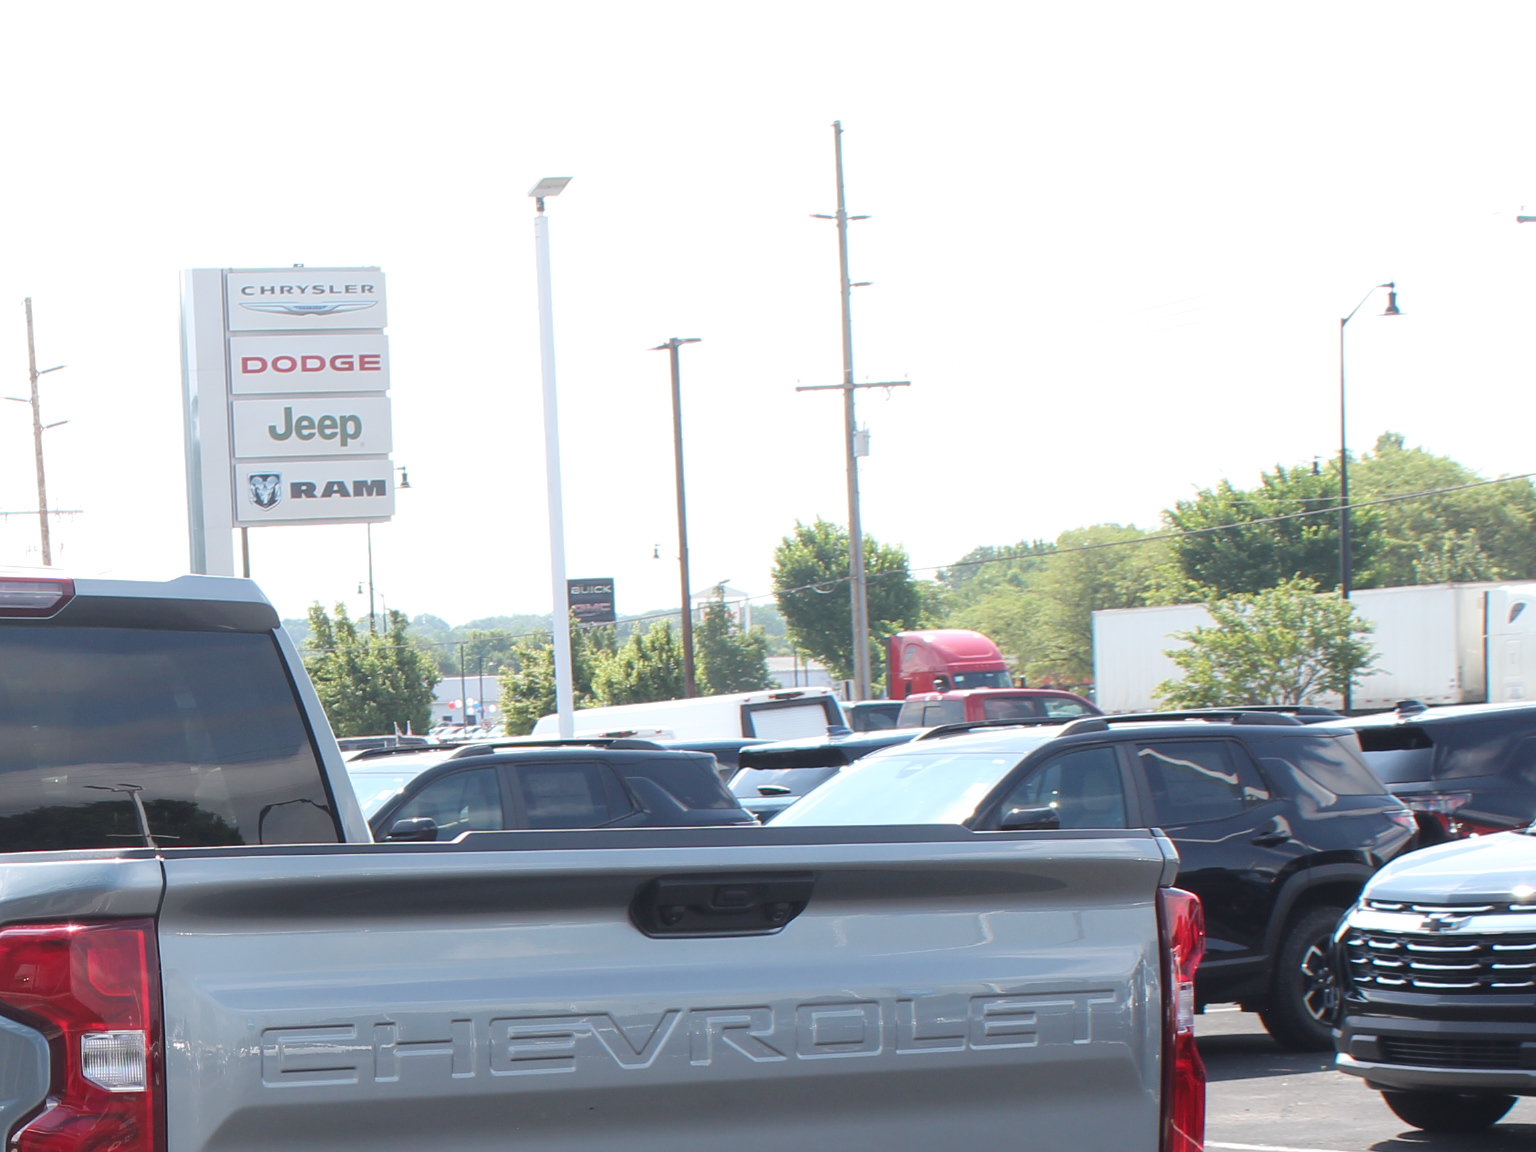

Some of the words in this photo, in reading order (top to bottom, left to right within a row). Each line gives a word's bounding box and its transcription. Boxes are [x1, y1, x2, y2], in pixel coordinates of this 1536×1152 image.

[241, 284, 375, 296] CHRYSLER
[241, 354, 382, 374] DODGE
[268, 406, 363, 447] Jeep
[290, 479, 387, 499] RAM
[571, 585, 612, 594] BUICK
[261, 989, 1117, 1089] CHEVROLET
